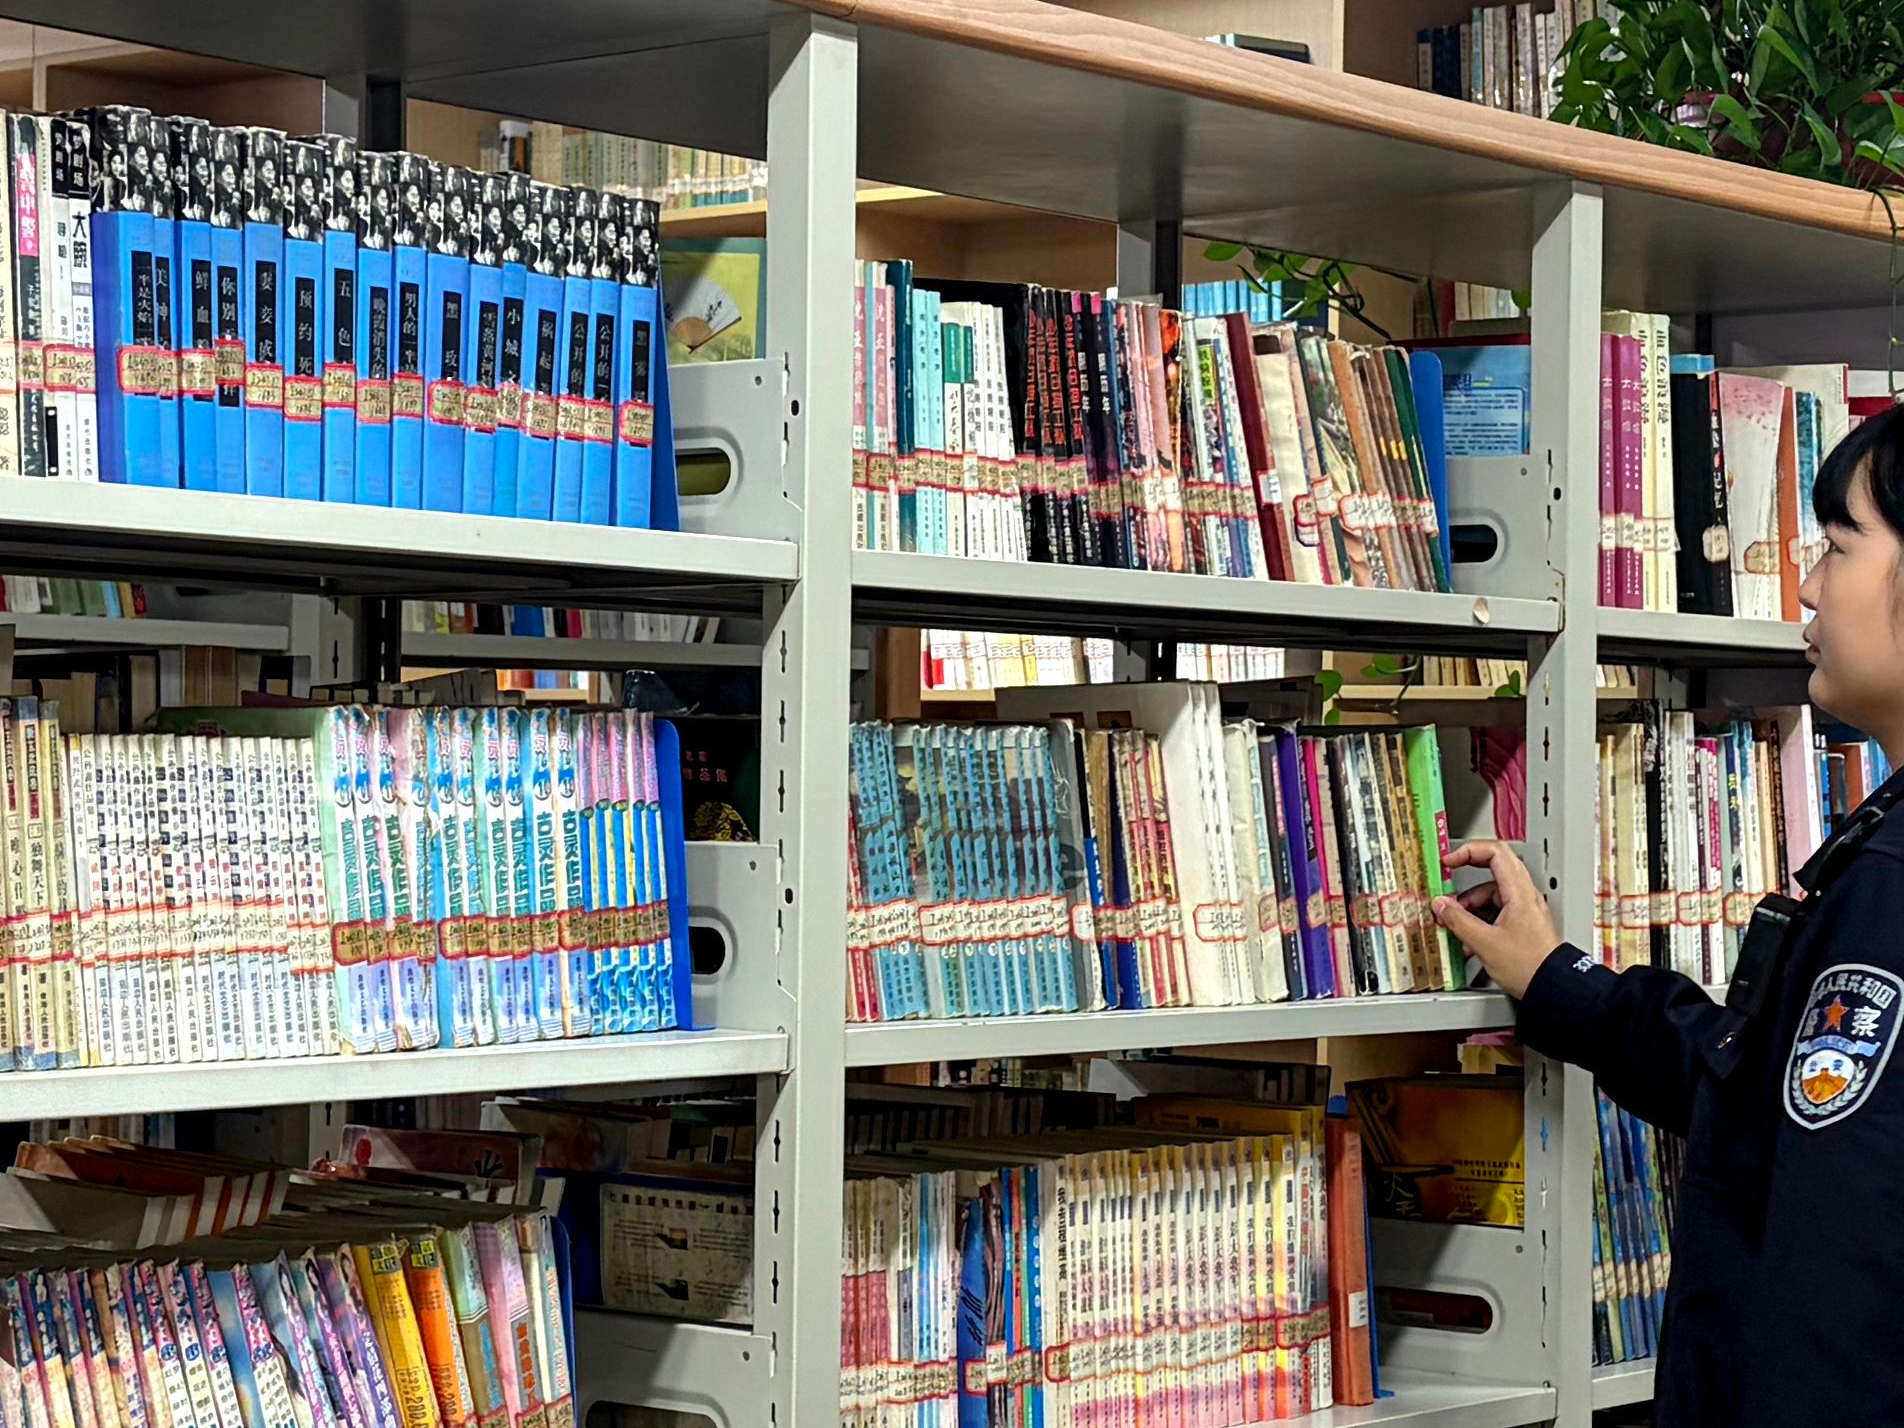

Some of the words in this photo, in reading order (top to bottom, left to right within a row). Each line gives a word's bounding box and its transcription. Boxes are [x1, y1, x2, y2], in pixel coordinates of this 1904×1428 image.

[1809, 972, 1898, 1010] 人民共和国
